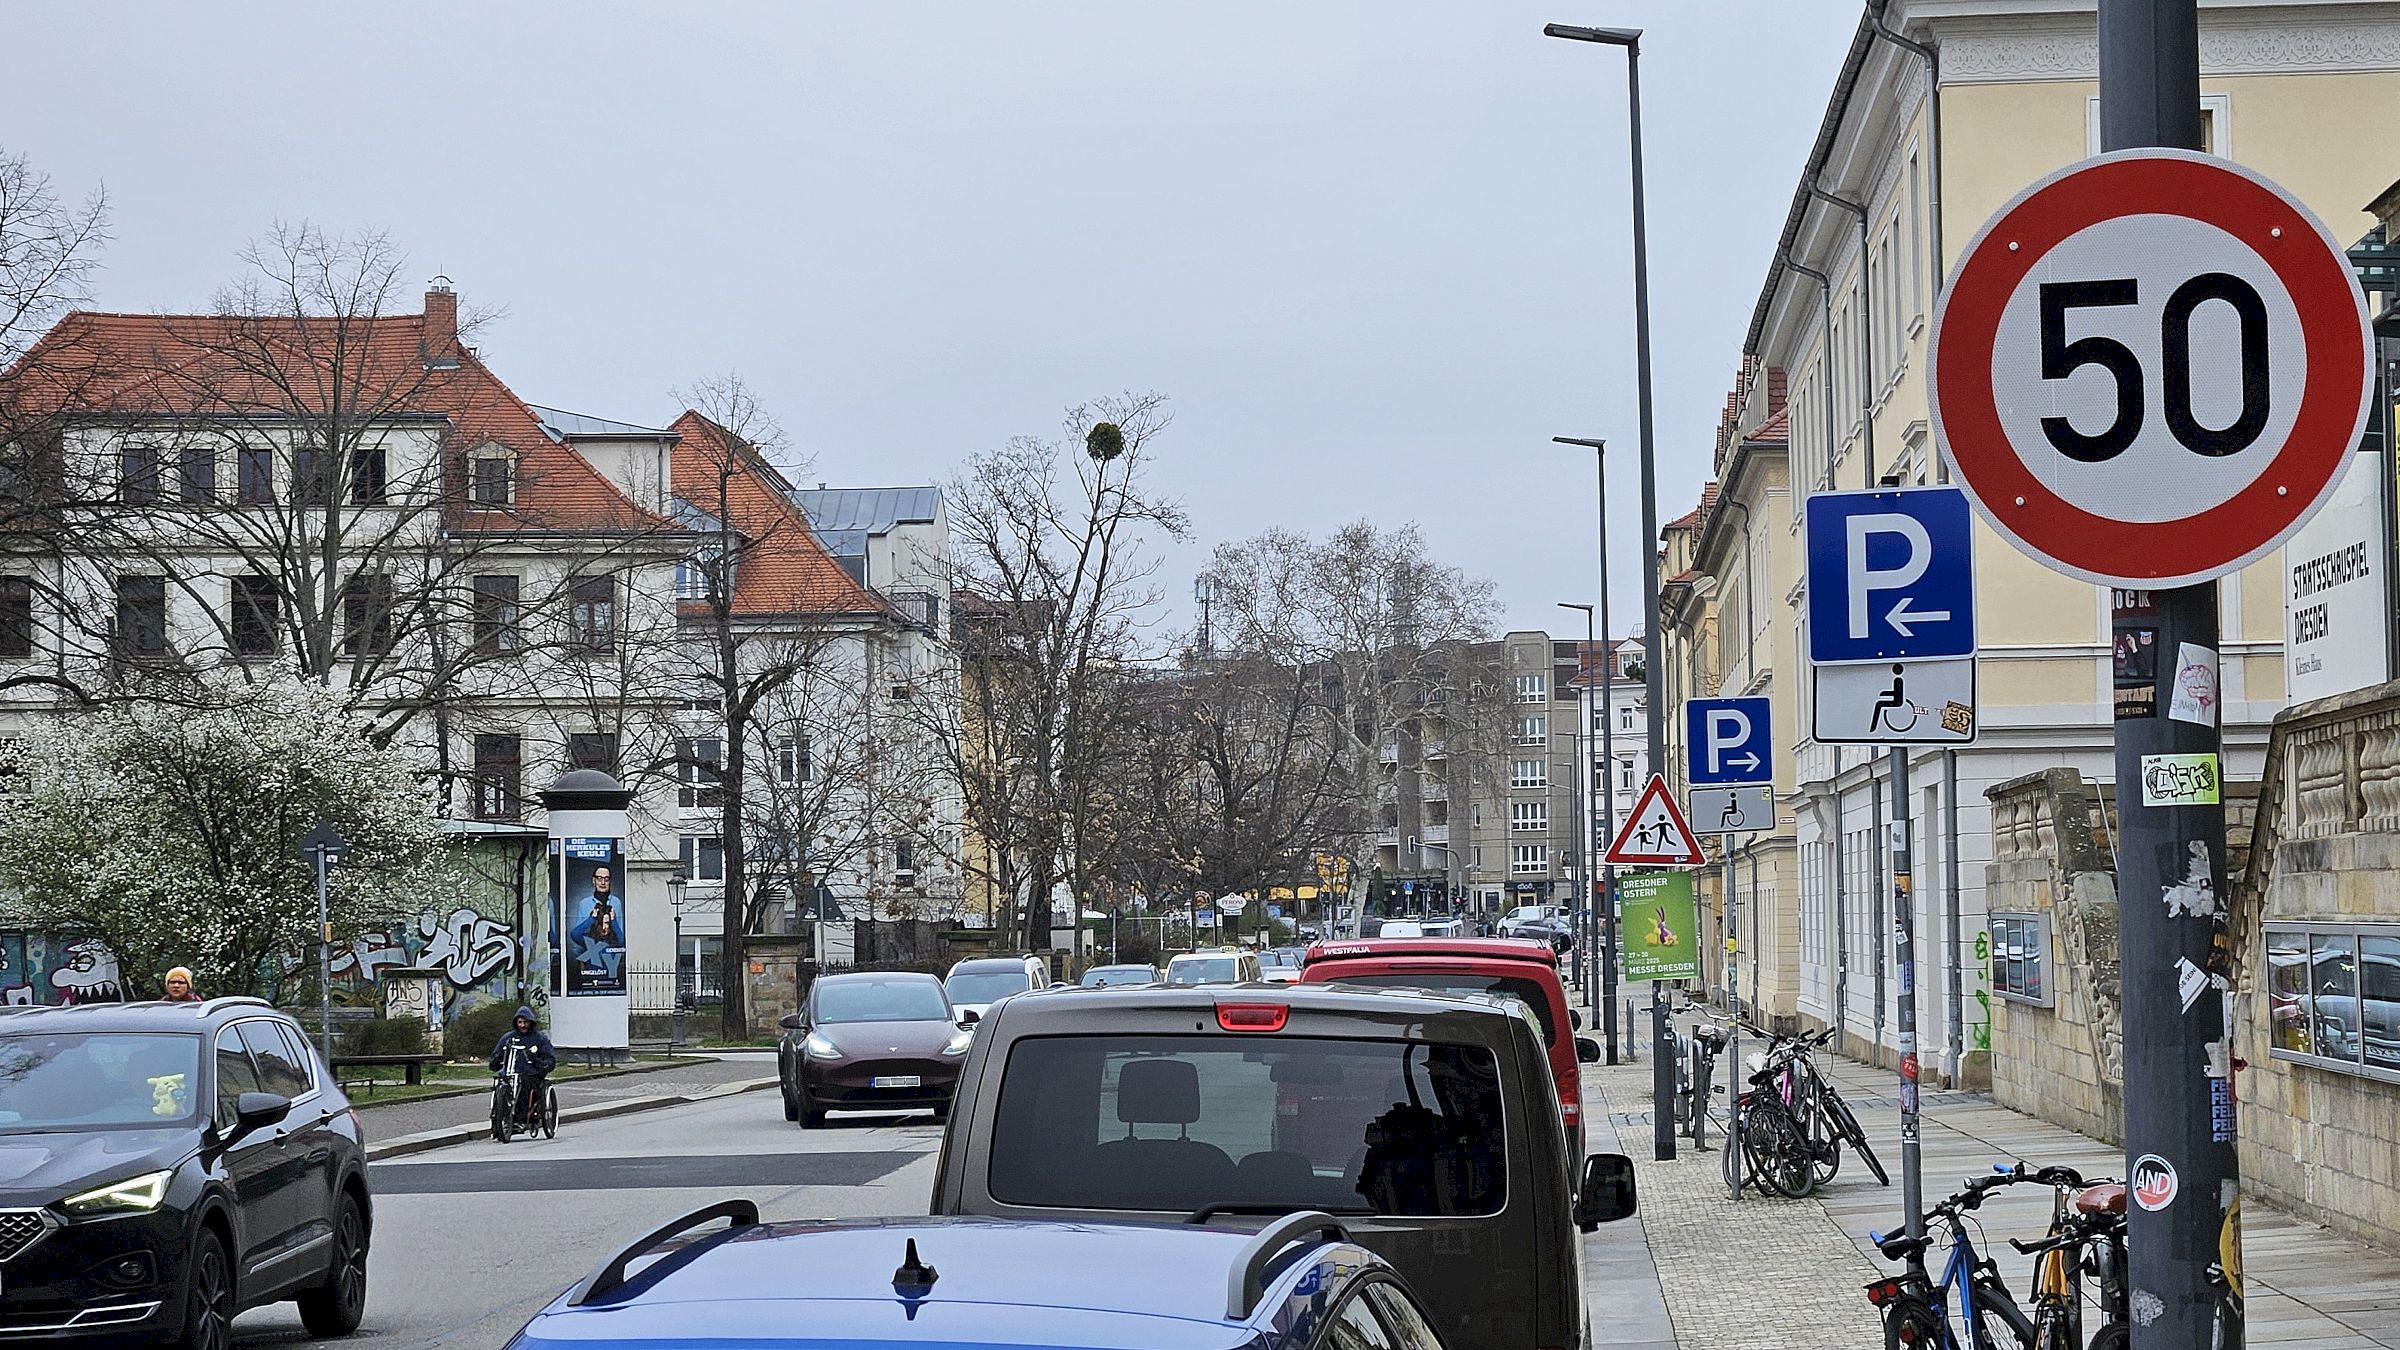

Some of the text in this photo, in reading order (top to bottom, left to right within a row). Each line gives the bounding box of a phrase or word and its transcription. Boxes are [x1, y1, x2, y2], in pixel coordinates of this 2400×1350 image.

[2039, 272, 2271, 463] 50
[1845, 512, 1932, 639] P
[2293, 540, 2370, 600] STAATSSCHAUSPIEL
[2294, 601, 2329, 646] DRESDEN
[1706, 709, 1752, 774] P
[566, 844, 611, 852] HERKULES
[577, 850, 606, 858] KEULE
[1622, 877, 1668, 889] DRESDNER
[1623, 887, 1657, 898] OSTERN
[1323, 946, 1371, 955] WESTFALIA
[1628, 964, 1657, 975] MESSE
[1657, 962, 1695, 973] DRESDEN
[2135, 1167, 2172, 1196] AND
